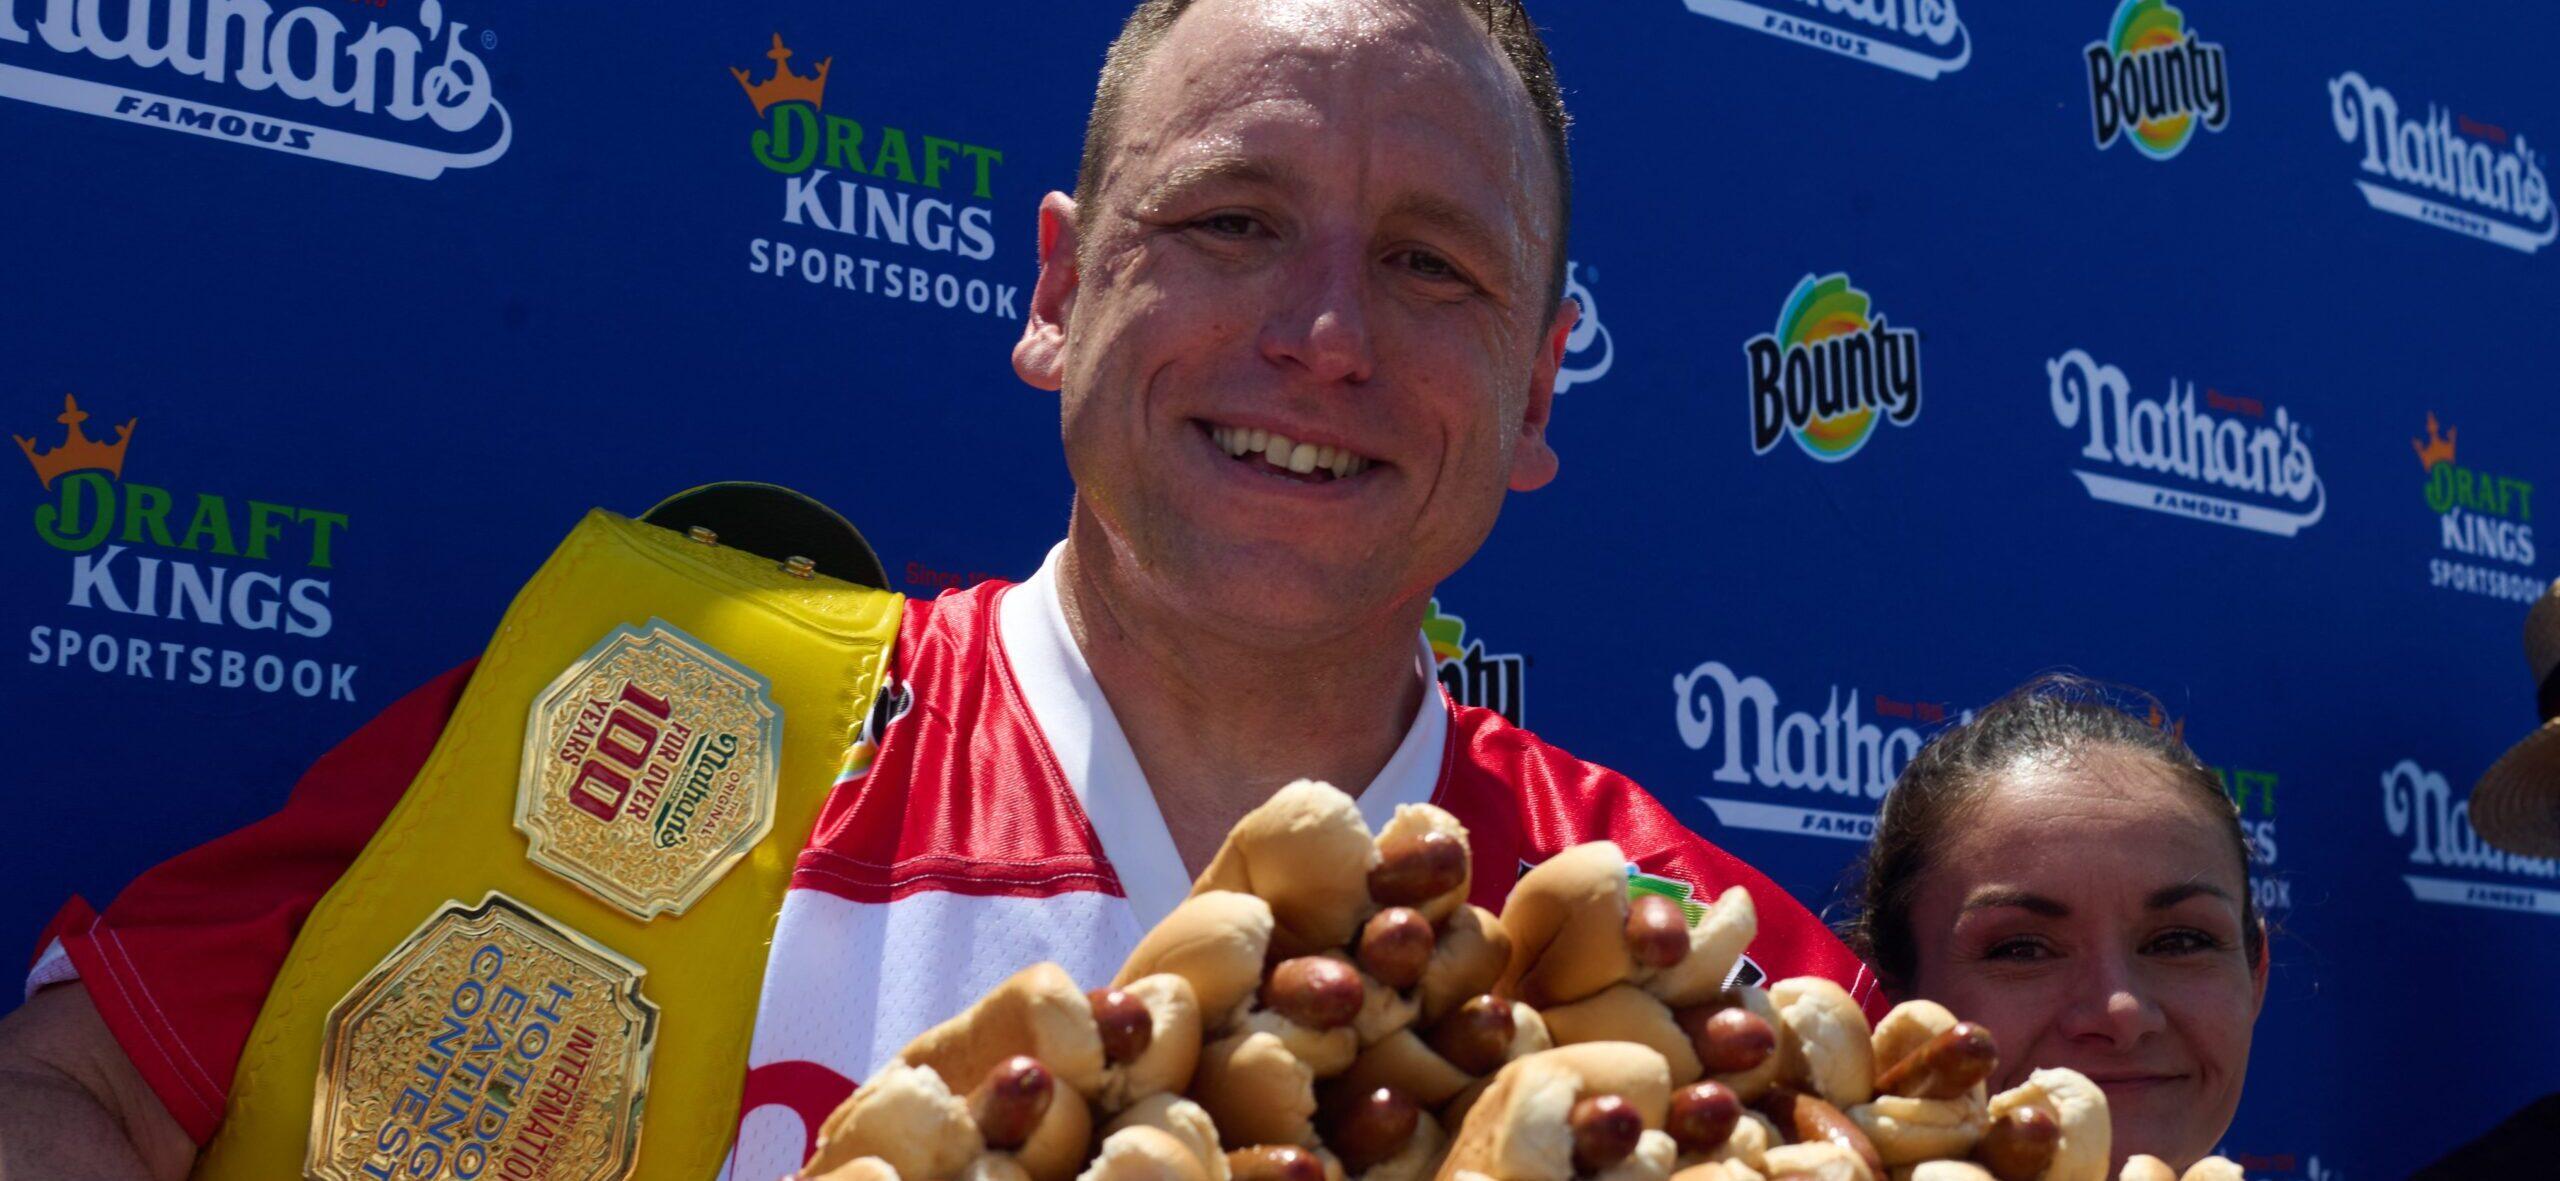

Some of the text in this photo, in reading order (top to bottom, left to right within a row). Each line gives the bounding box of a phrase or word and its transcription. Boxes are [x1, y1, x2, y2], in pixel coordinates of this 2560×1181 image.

[1763, 15, 1869, 56] FAMOUS
[115, 96, 315, 151] FAMOUS
[2085, 30, 2228, 147] Bounty
[752, 104, 1003, 199] DRAFT
[2328, 71, 2550, 222] Nathan's
[782, 168, 996, 261] KINGS
[749, 238, 1018, 320] SPORTSBOOK
[1747, 315, 1919, 452] Bounty
[2047, 348, 2314, 502] Nathan's
[34, 472, 349, 568] DRAFT
[2153, 491, 2242, 522] FAMOUS
[2424, 462, 2534, 521] DRAFT
[2441, 505, 2536, 566] KINGS
[67, 544, 333, 638] KINGS
[28, 625, 358, 702] SPORTSBOOK
[560, 697, 612, 766] YEARS
[569, 680, 672, 823] 100
[656, 721, 692, 763] FOR
[1673, 661, 1924, 799] Natha
[626, 763, 670, 822] OVER
[660, 733, 738, 848] Nathan's
[701, 771, 740, 836] ORIGINAL
[1803, 814, 1875, 837] FAMO
[409, 985, 528, 1181] EATING
[454, 982, 574, 1181] HOT DO
[497, 1024, 598, 1181] INTERNATIO
